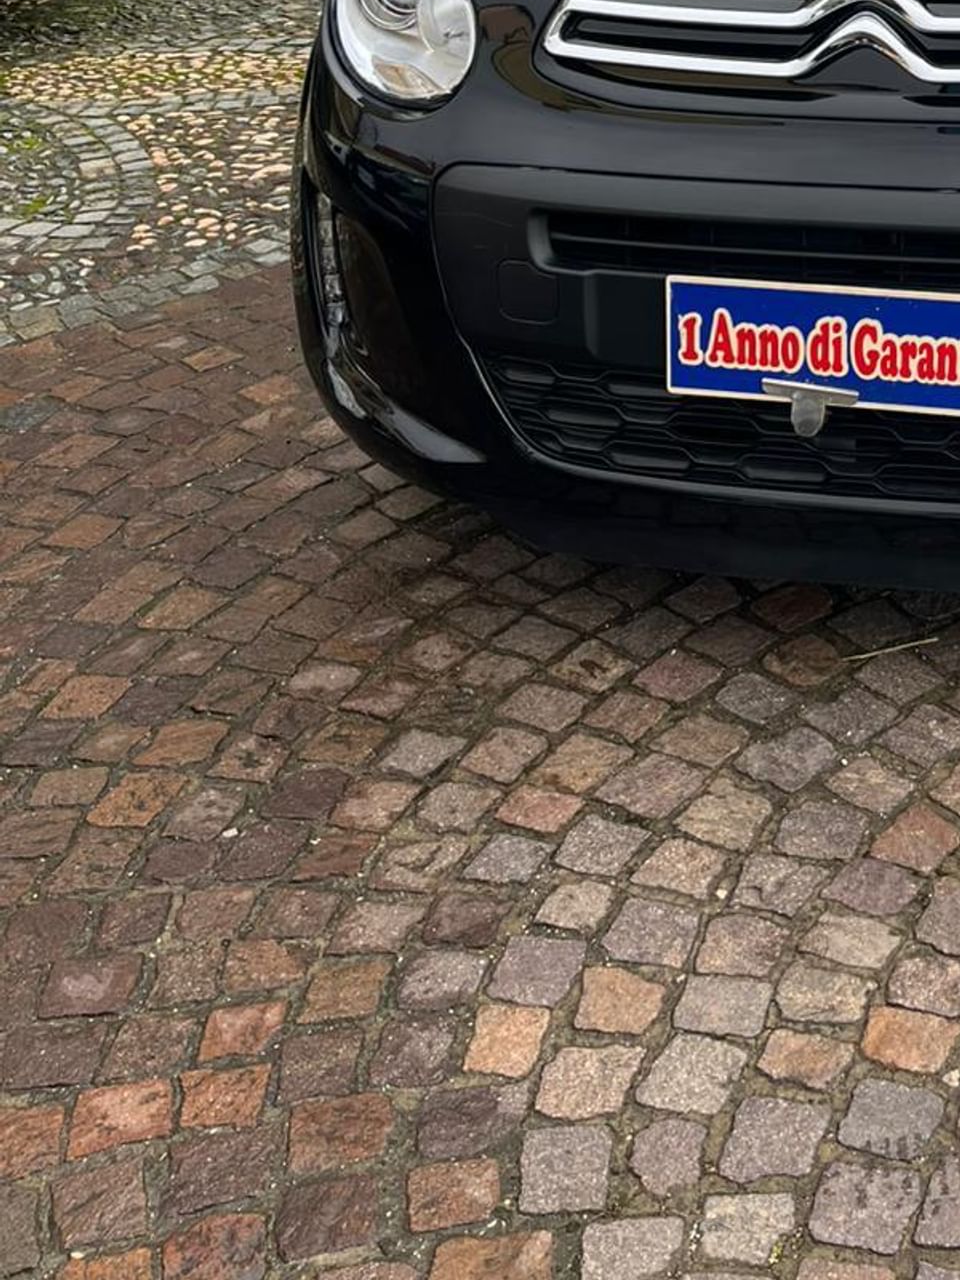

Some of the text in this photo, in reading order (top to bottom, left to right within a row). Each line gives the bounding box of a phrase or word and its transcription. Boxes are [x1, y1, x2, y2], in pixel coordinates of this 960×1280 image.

[679, 312, 703, 365] 1
[707, 308, 804, 373] Anno
[807, 316, 848, 377] di
